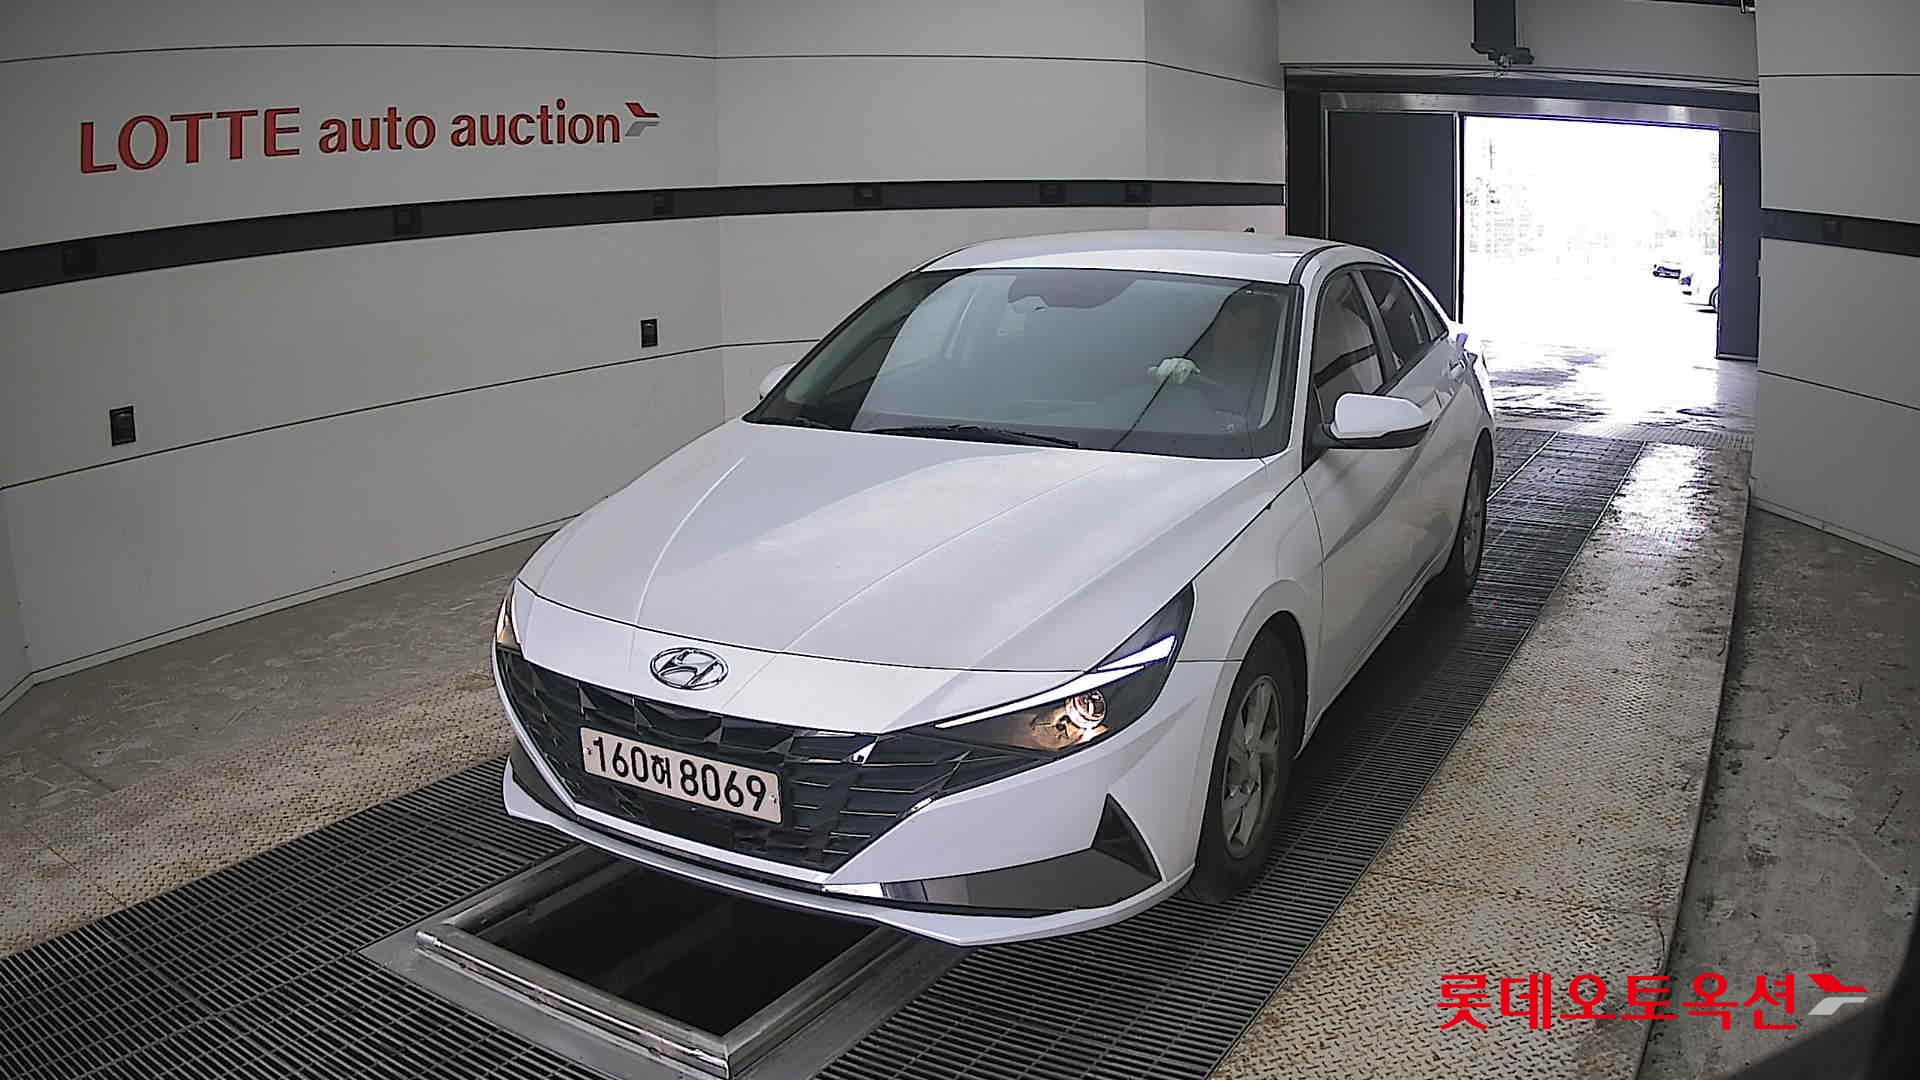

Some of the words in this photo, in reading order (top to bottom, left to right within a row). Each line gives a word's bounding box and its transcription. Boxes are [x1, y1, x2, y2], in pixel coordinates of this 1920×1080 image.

[80, 107, 301, 174] LOTTE
[318, 106, 436, 154] auto
[450, 98, 622, 146] auction
